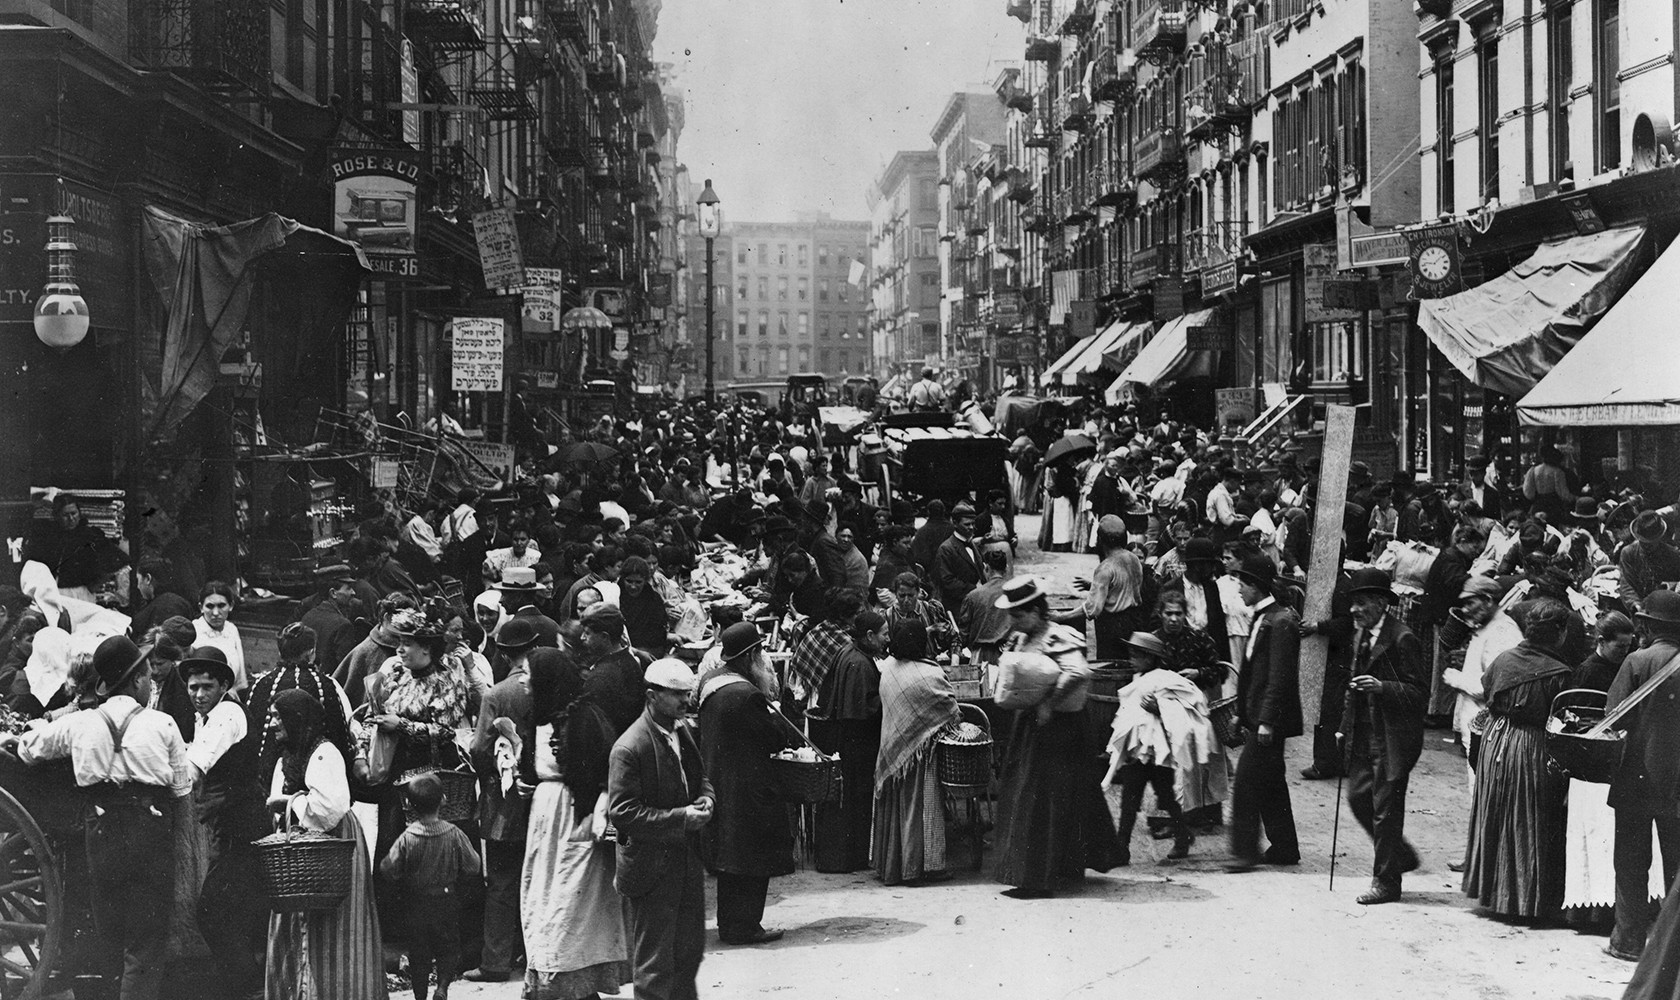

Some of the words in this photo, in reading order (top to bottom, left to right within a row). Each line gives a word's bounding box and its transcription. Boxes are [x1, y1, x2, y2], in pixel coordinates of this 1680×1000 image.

[332, 156, 377, 177] ROSE
[382, 158, 394, 171] &
[397, 160, 419, 181] CO.
[400, 258, 418, 275] 36
[539, 311, 554, 322] 32
[1585, 405, 1618, 421] CREAM
